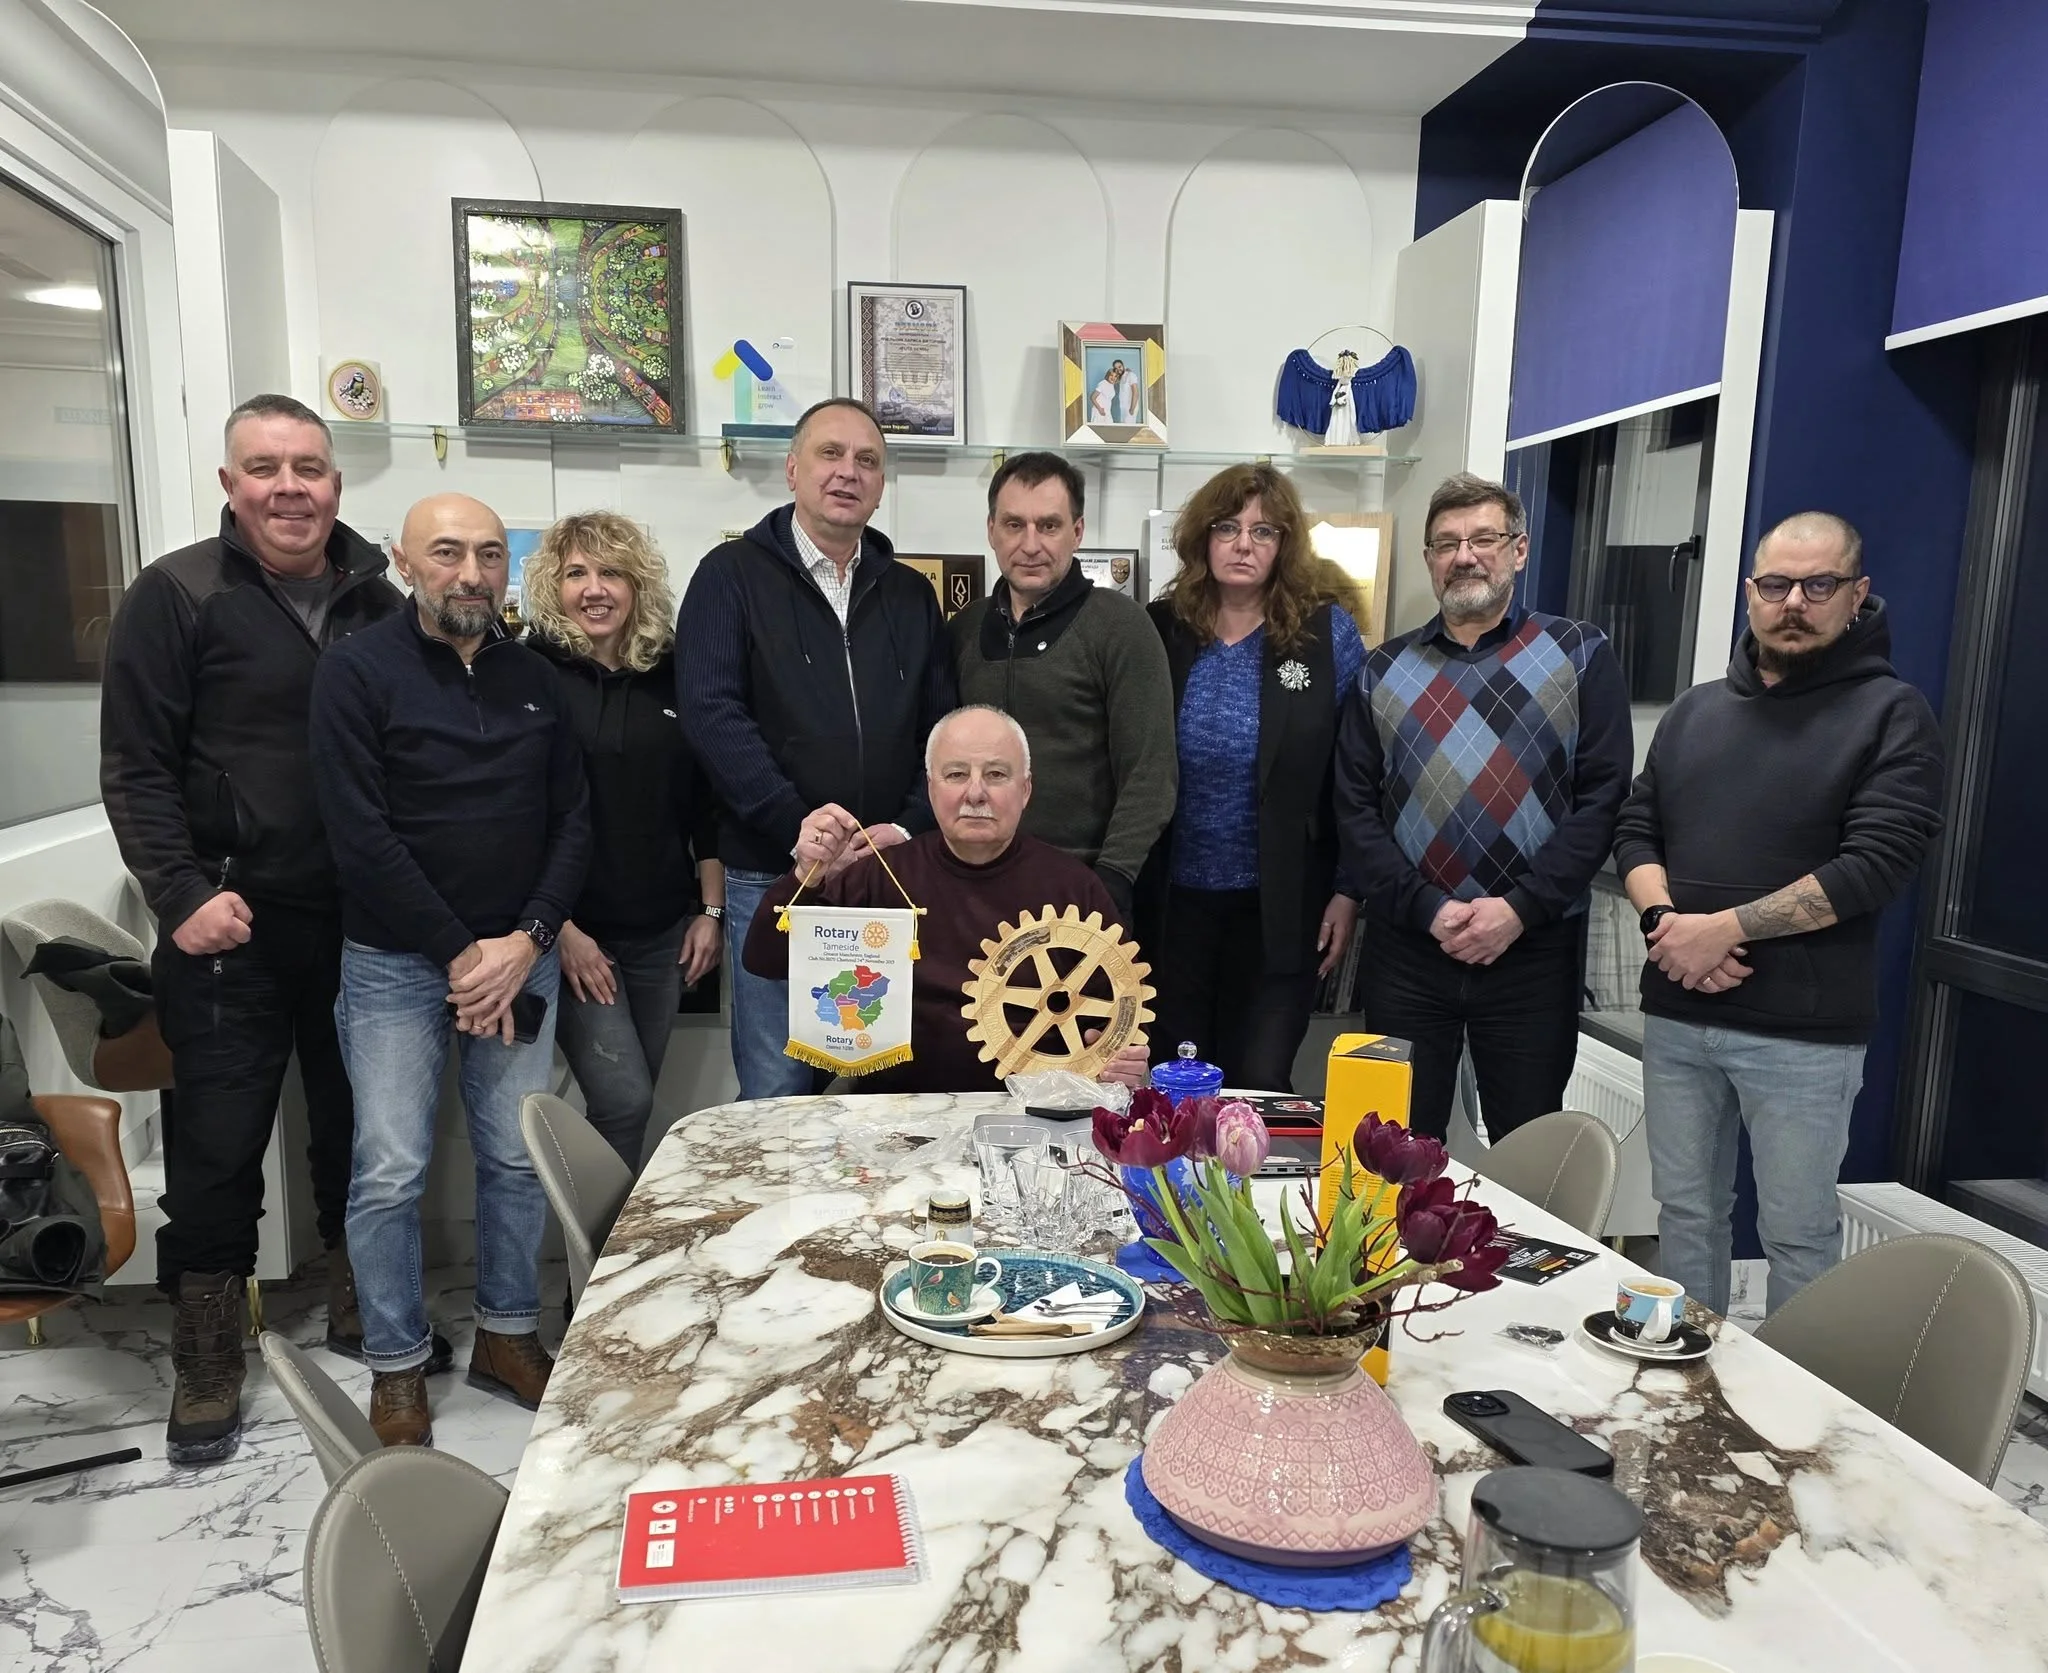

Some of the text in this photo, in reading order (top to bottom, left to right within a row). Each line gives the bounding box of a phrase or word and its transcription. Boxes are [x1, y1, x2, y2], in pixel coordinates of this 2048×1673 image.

[814, 926, 859, 941] Rotary
[823, 943, 859, 951] Tameside
[826, 1035, 853, 1045] Rotary
